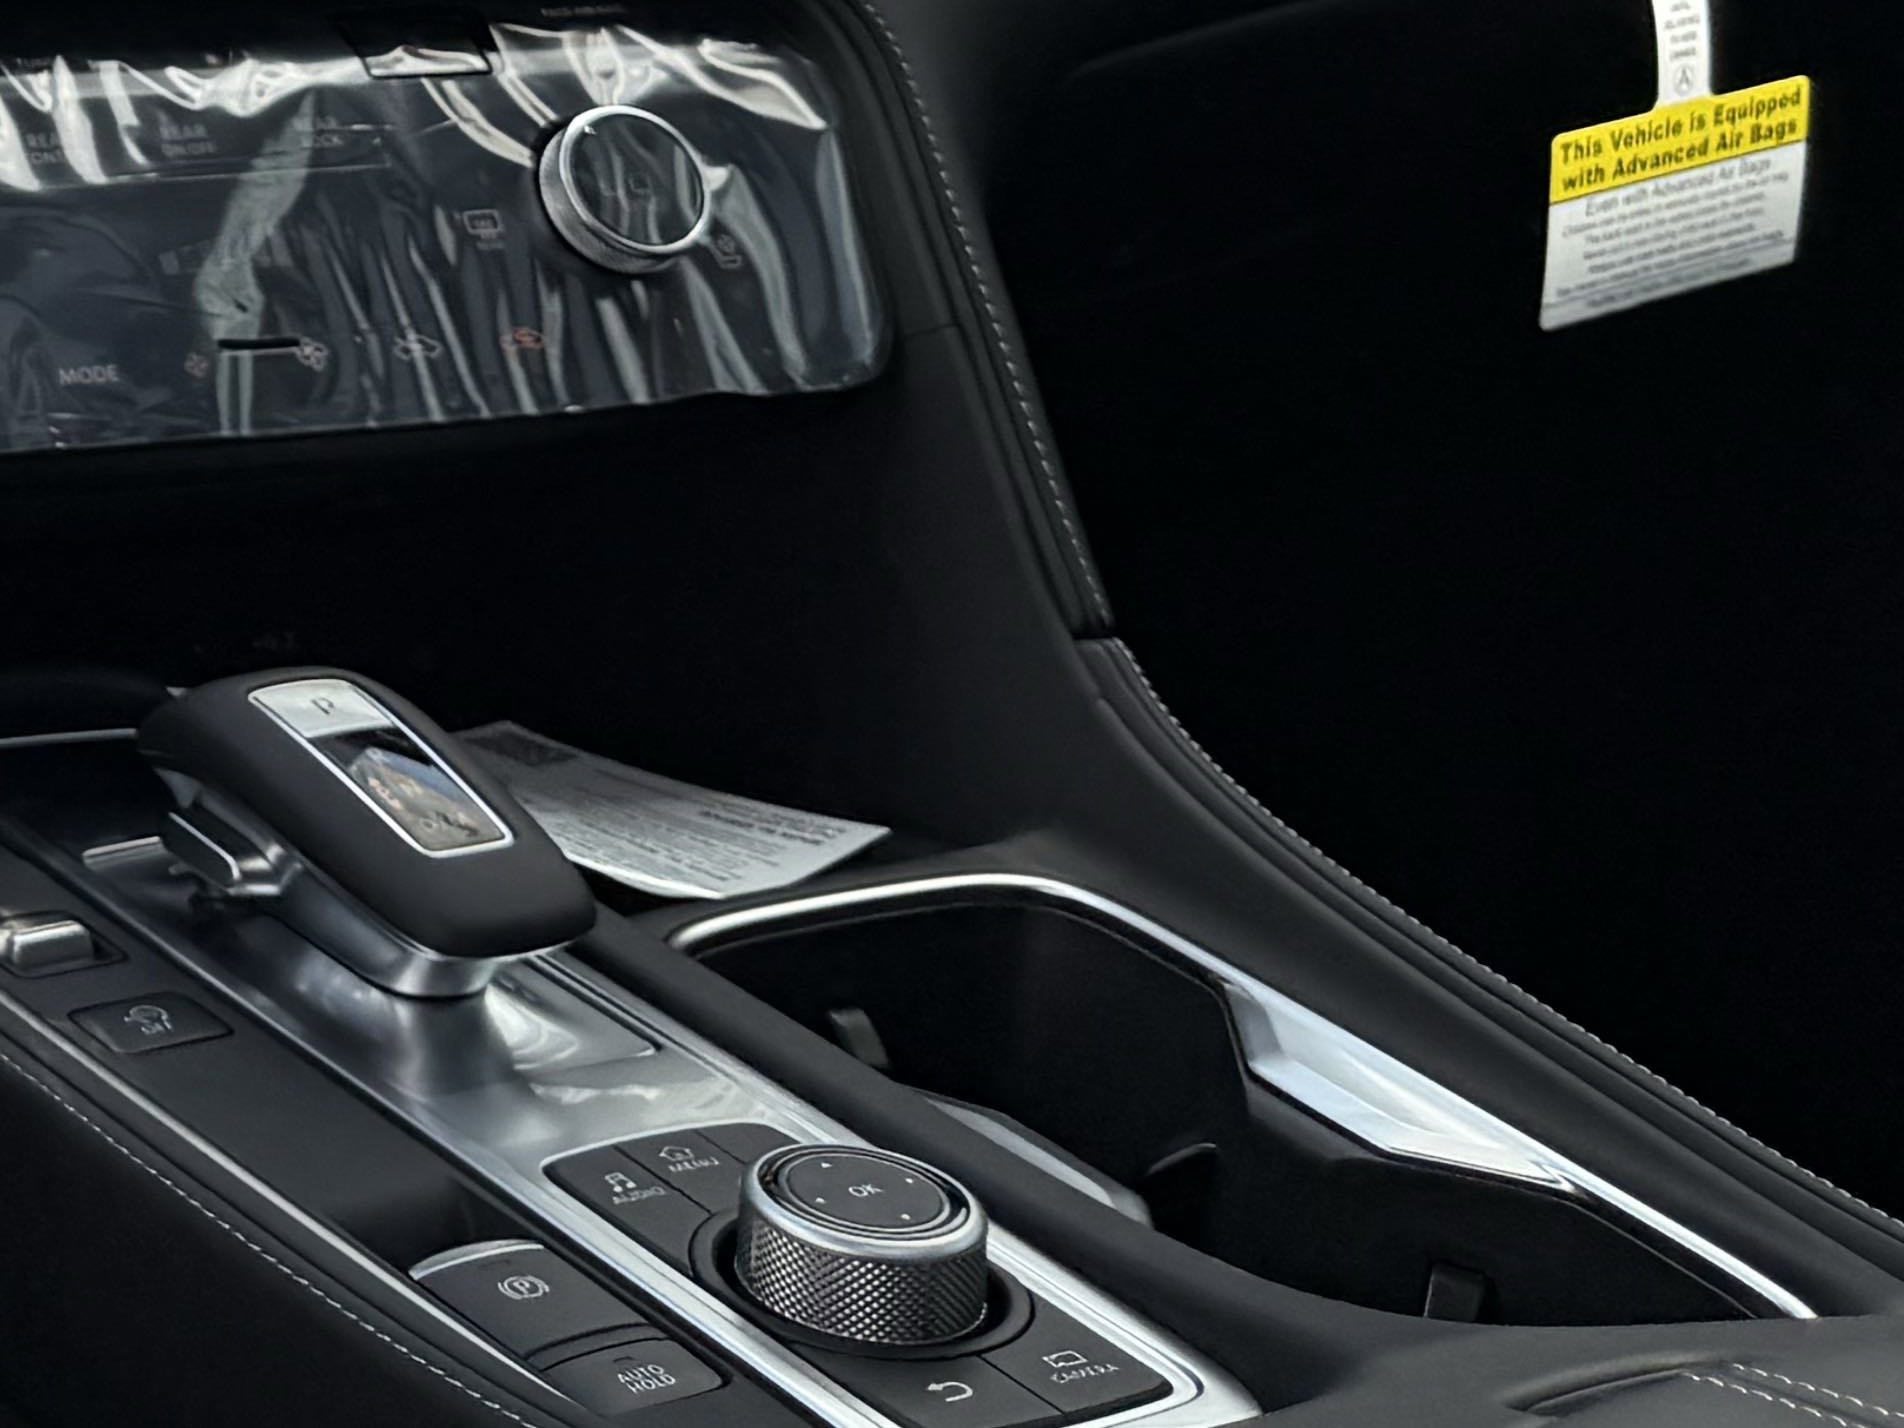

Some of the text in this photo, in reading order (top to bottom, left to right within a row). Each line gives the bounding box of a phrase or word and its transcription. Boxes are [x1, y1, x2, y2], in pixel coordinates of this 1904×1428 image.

[1560, 85, 1802, 165] This Vehicle is Equipped
[1562, 118, 1798, 192] with Advanced Air Bags
[59, 363, 119, 386] MODE
[847, 1182, 884, 1199] OK
[617, 1363, 666, 1385] AUTO
[624, 1373, 677, 1396] HOLD
